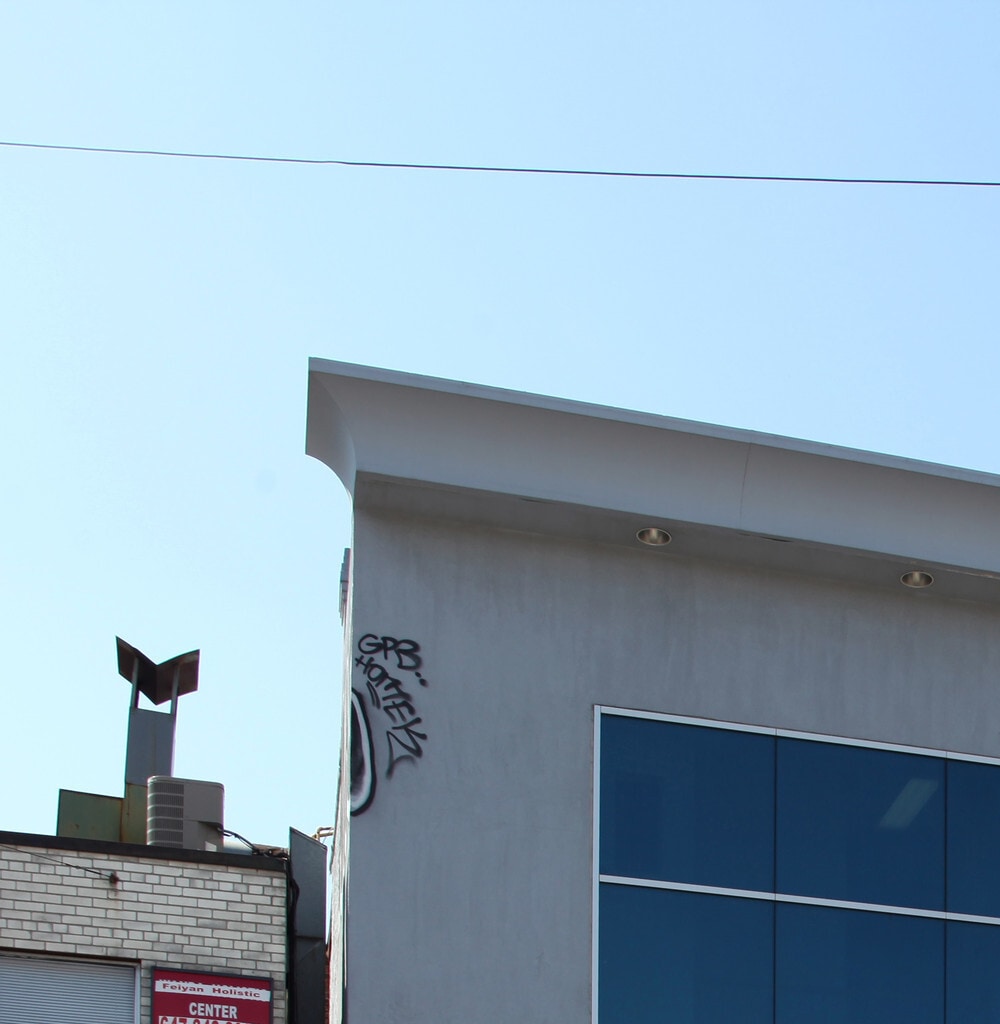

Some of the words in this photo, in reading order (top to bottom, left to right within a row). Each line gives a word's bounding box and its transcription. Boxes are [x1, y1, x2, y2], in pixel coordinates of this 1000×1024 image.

[162, 983, 204, 992] Feiyan
[212, 988, 261, 998] Holistic
[189, 1002, 238, 1019] CENTER
